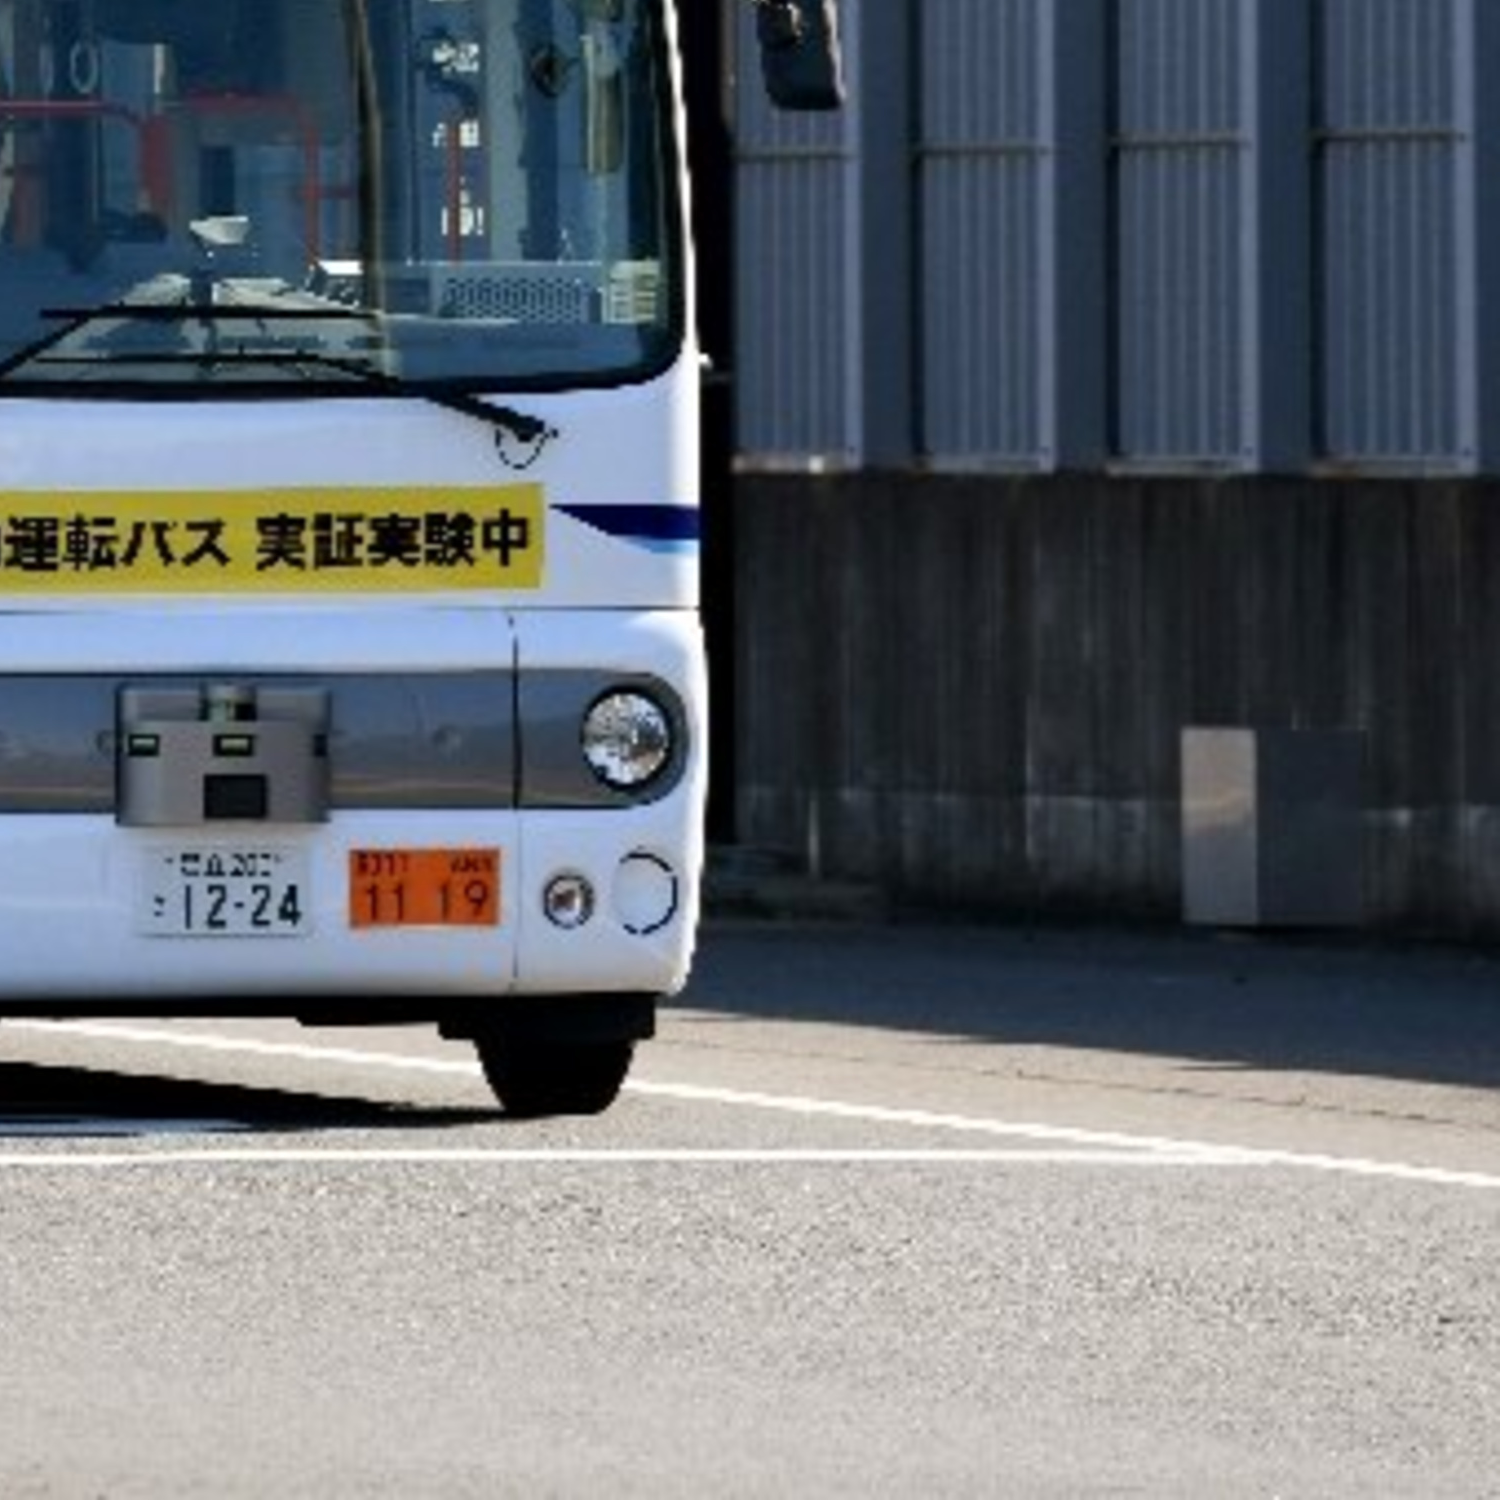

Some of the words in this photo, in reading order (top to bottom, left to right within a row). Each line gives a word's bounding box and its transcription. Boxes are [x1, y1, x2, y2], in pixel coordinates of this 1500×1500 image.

[256, 510, 529, 569] 実証実験中
[185, 884, 302, 930] 12-24
